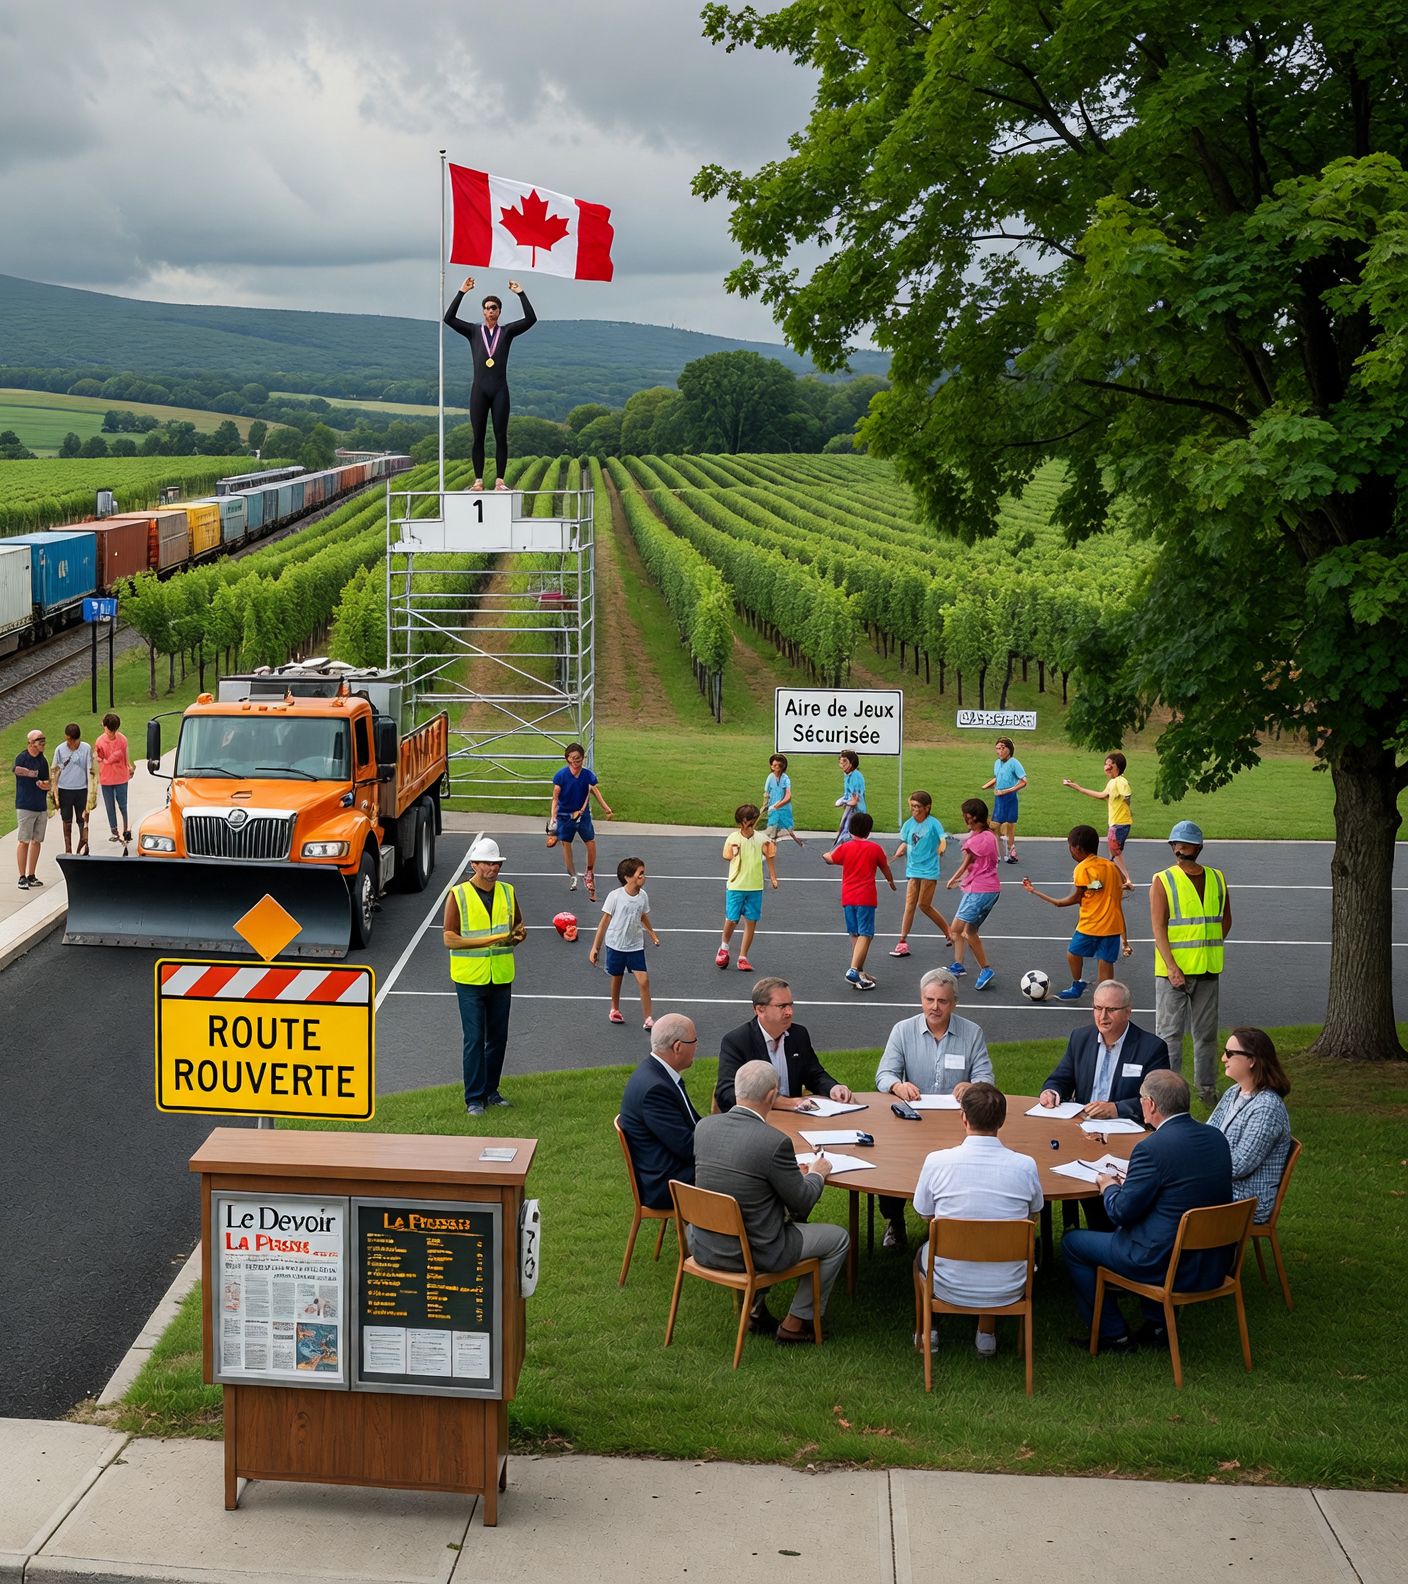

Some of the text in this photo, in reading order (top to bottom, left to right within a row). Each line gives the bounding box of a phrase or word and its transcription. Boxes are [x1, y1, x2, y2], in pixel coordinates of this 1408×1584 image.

[473, 499, 484, 523] 1
[785, 697, 894, 718] Aire de Jeux
[793, 723, 881, 744] Sécurisée
[208, 1014, 321, 1051] ROUTE
[174, 1058, 355, 1098] ROUVERTE
[226, 1204, 336, 1233] Le Devoir
